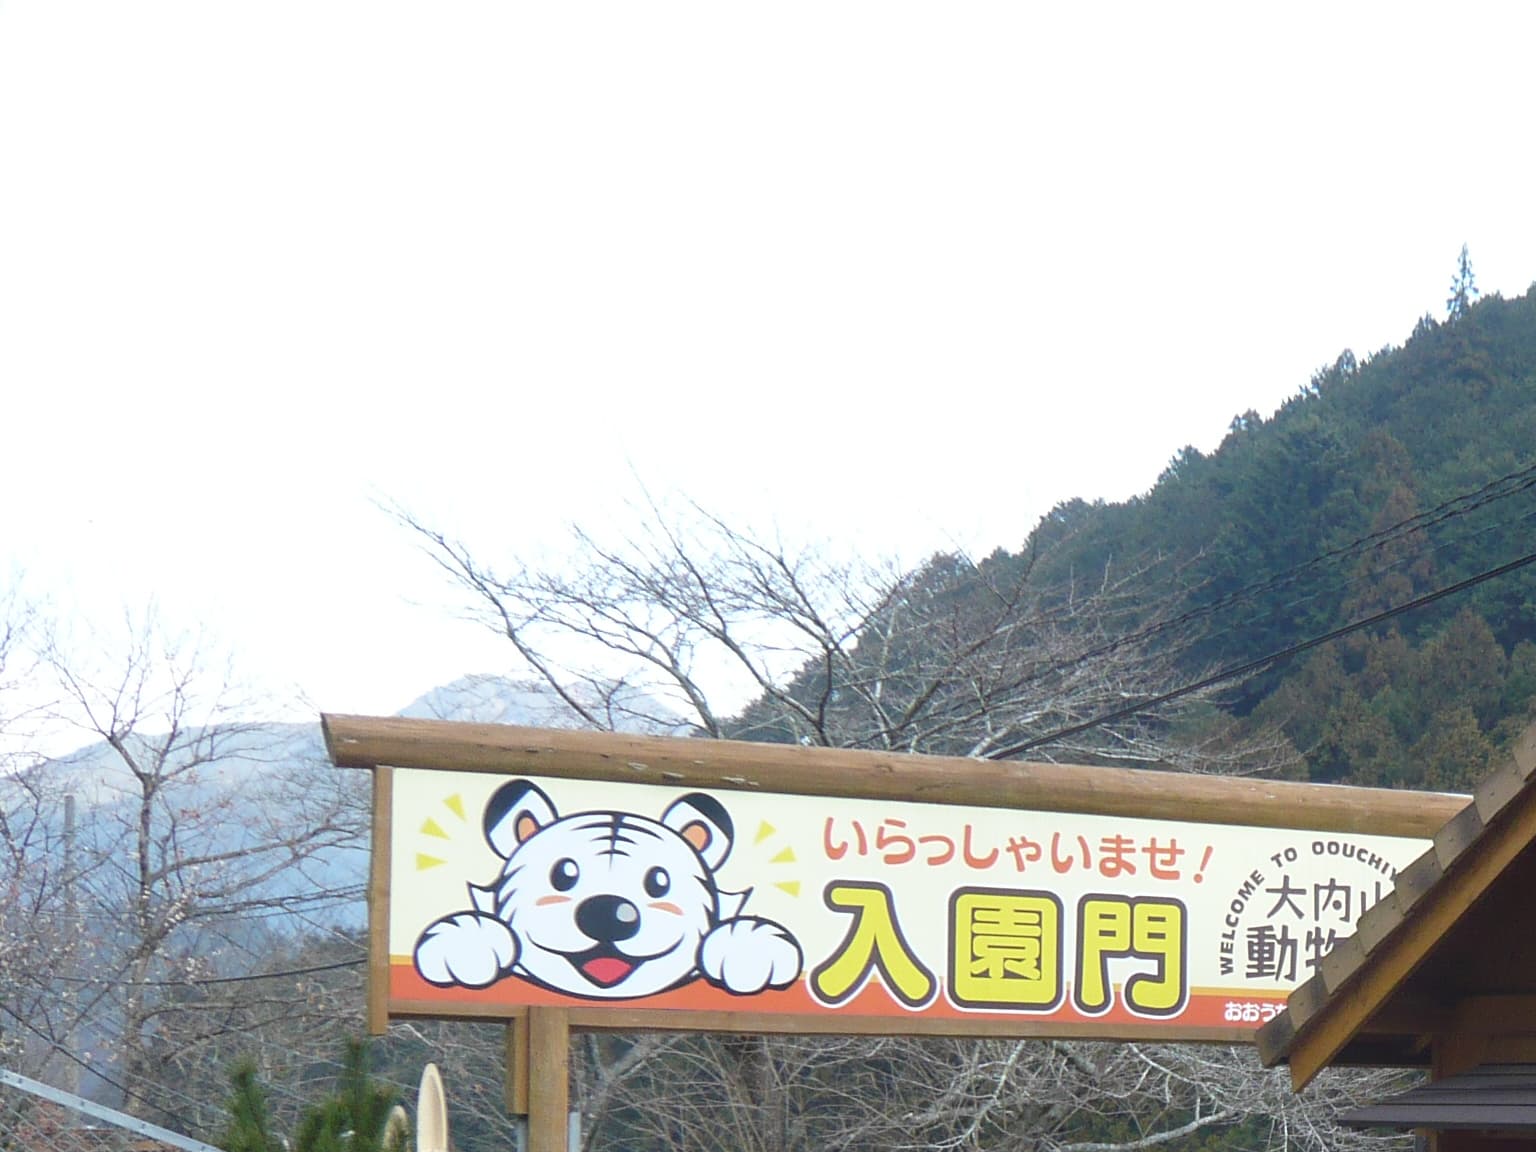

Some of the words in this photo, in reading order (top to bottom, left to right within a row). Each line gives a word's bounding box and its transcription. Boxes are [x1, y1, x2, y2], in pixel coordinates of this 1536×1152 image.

[807, 879, 1189, 1017] 入園門
[1220, 869, 1265, 976] WELCOME
[1270, 847, 1298, 868] TO
